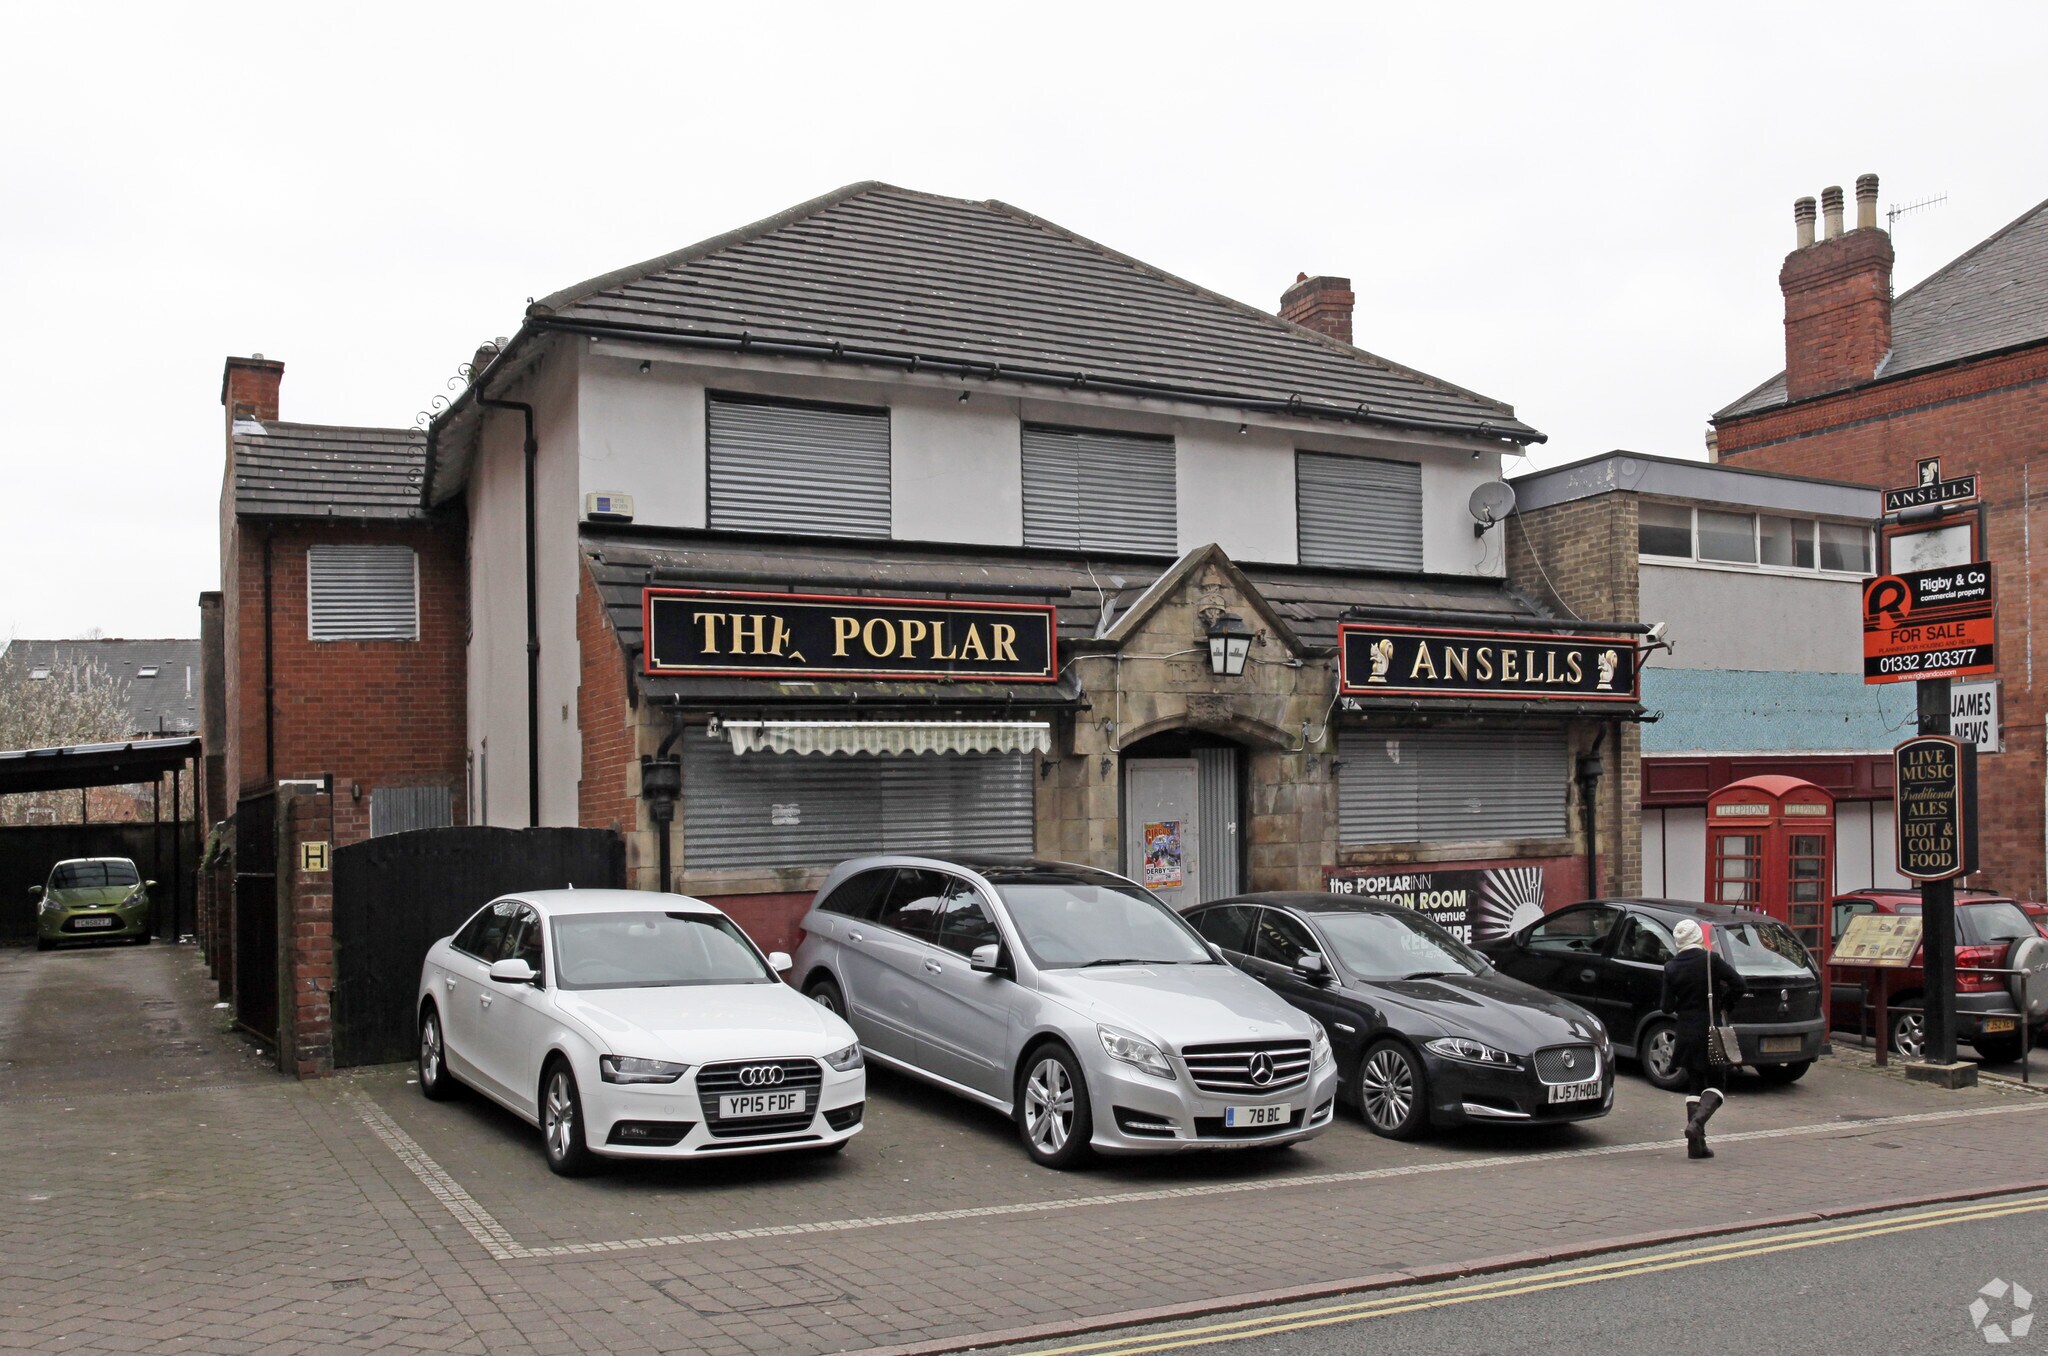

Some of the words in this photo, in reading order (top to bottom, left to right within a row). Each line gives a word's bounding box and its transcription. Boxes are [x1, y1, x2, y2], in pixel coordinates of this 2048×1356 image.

[1889, 481, 1971, 507] ANSELLS
[1920, 577, 1952, 592] Rigby
[1955, 574, 1965, 586] &
[1968, 572, 1985, 584] Co
[1920, 590, 1956, 602] commercial
[1957, 587, 1985, 598] property
[693, 612, 806, 663] THE
[831, 616, 1019, 662] POPLAR
[1891, 628, 1921, 644] FOR
[1926, 623, 1966, 640] SALE
[1879, 646, 1905, 654] PLANNING
[1920, 642, 1942, 650] HOUSING
[1943, 640, 1957, 648] AND
[1409, 640, 1582, 684] ANSELLS
[1880, 654, 1919, 673] 01332
[1924, 648, 1976, 669] 203377
[1898, 669, 1957, 681] www.rigbyandco.com
[1951, 692, 1991, 717] JAMES
[1955, 720, 1989, 744] NEWS
[1909, 749, 1946, 766] LIVE
[1902, 764, 1954, 780] MUSIC
[1901, 784, 1957, 802] Traditional
[1718, 804, 1769, 815] TELEPHONE
[1908, 801, 1948, 817] ALES
[1146, 828, 1171, 845] CIRCUS
[1904, 822, 1937, 837] HOT
[1942, 822, 1954, 836] &
[1908, 837, 1952, 852] COLD
[305, 844, 324, 869] H
[1909, 852, 1952, 867] FOOD
[1146, 867, 1167, 875] DERBY
[1329, 878, 1353, 894] the
[1419, 889, 1467, 910] ROOM
[1552, 1084, 1578, 1101] AJ57
[730, 1096, 764, 1114] YP15
[768, 1093, 797, 1111] FDF
[1249, 1108, 1265, 1124] 78
[1267, 1106, 1281, 1122] BC
